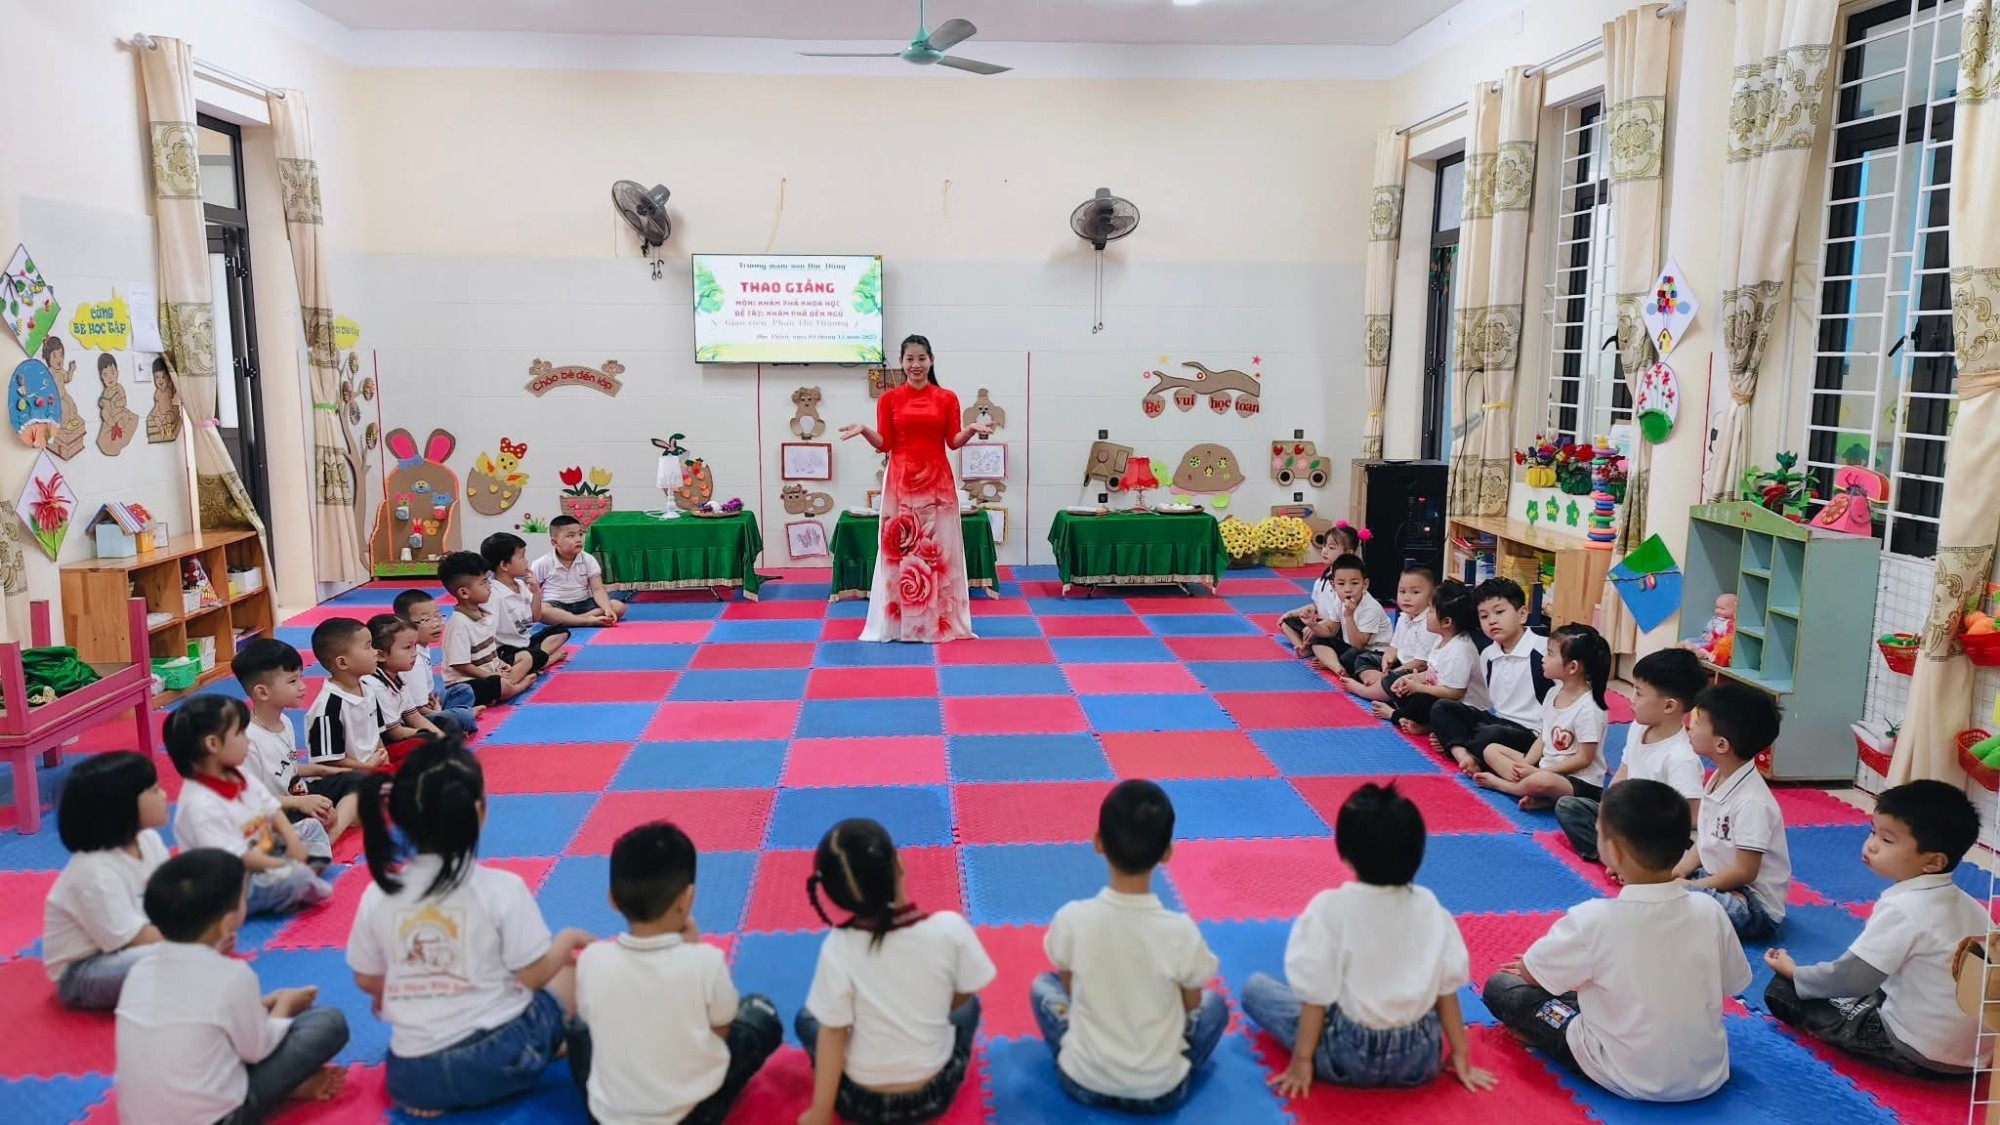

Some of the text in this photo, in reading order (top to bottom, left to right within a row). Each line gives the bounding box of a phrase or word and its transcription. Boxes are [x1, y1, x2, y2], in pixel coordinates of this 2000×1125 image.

[740, 278, 835, 293] THAO GIẢNG
[91, 305, 113, 319] CÙNG
[73, 320, 87, 334] BÉ
[532, 374, 559, 391] Chào
[561, 369, 575, 380] bé
[576, 370, 595, 382] đến
[1145, 401, 1161, 414] Bé
[1175, 395, 1195, 406] vui
[1210, 396, 1232, 411] học
